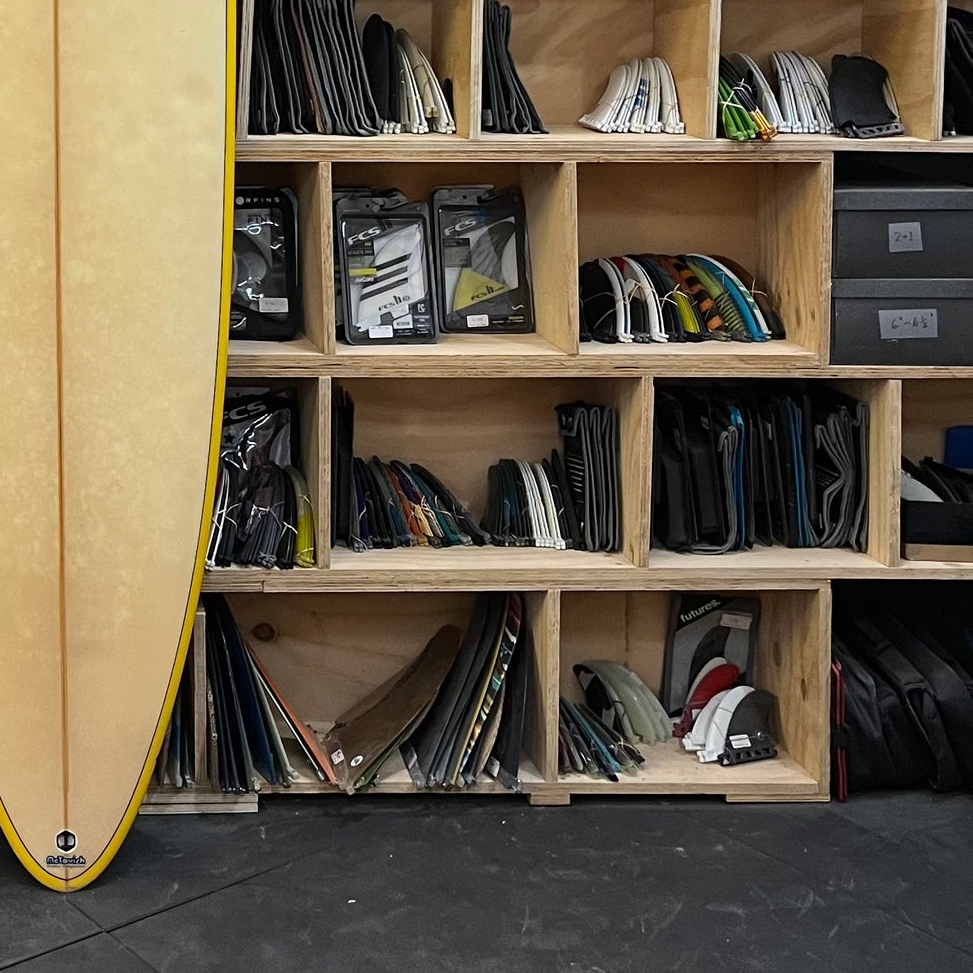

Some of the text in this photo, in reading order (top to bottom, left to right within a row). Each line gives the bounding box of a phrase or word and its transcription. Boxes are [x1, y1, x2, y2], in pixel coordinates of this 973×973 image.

[347, 226, 381, 246] FCS
[444, 217, 477, 236] FCS
[680, 599, 721, 623] futures.
[46, 855, 86, 865] McTavish
